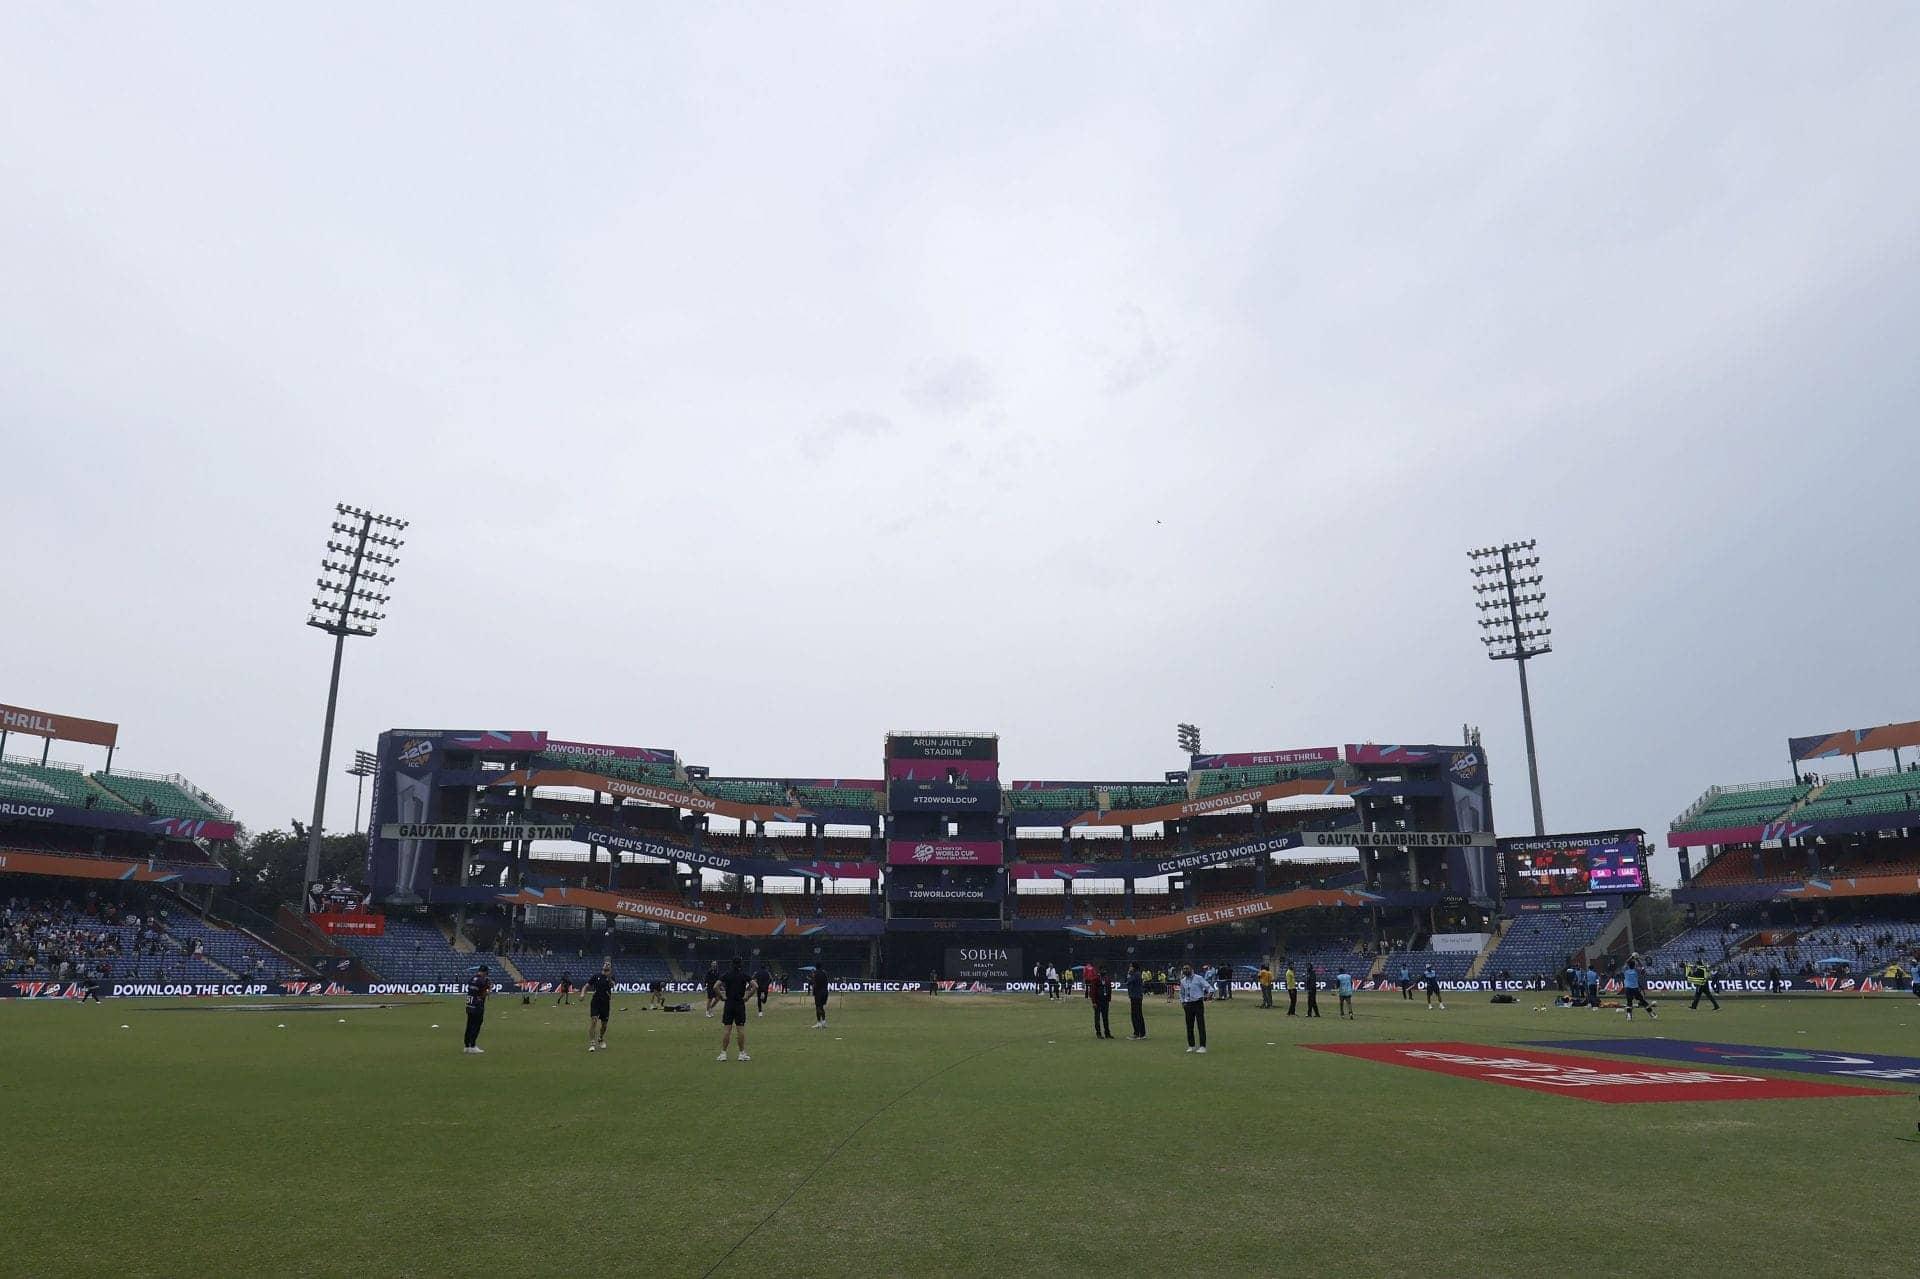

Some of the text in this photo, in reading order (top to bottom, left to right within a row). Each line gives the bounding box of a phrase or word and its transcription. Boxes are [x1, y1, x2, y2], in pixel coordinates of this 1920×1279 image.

[913, 739, 973, 747] ARUN JAITLEY
[924, 748, 962, 756] STADIUM
[1253, 752, 1323, 764] FEEL THE THRILL
[606, 781, 716, 810] T20WORLDCUP.COM
[913, 796, 978, 804] #T20WORLDCUP
[1182, 791, 1262, 813] #T20WORLDCUP
[0, 804, 54, 818] RLDCUP
[400, 825, 573, 839] GAUTAM GAMBHIR STAND
[1318, 833, 1472, 846] GAUTAM GAMBHIR STAND
[1526, 842, 1551, 850] MEN'S
[1552, 840, 1568, 848] T20
[1568, 838, 1600, 848] WORLD
[1601, 837, 1620, 845] CUP
[587, 831, 731, 869] ICC MEN'S T20 WORLD CUP
[1157, 838, 1289, 873] ICC MEN'S T20 WORLD CUP
[616, 901, 708, 924] #T20WORLDCUP
[1186, 901, 1273, 925] FEEL THE THRILL
[960, 948, 1008, 960] SOBHA
[113, 984, 268, 996] DOWNLOAD THE ICC APP
[368, 984, 436, 994] DOWNLOAD
[438, 984, 459, 993] THE
[677, 983, 694, 992] ICC
[803, 982, 921, 991] DNLOAD THE ICC APP
[1504, 981, 1522, 989] ICC
[1719, 981, 1743, 990] THE
[1746, 981, 1766, 990] ICC
